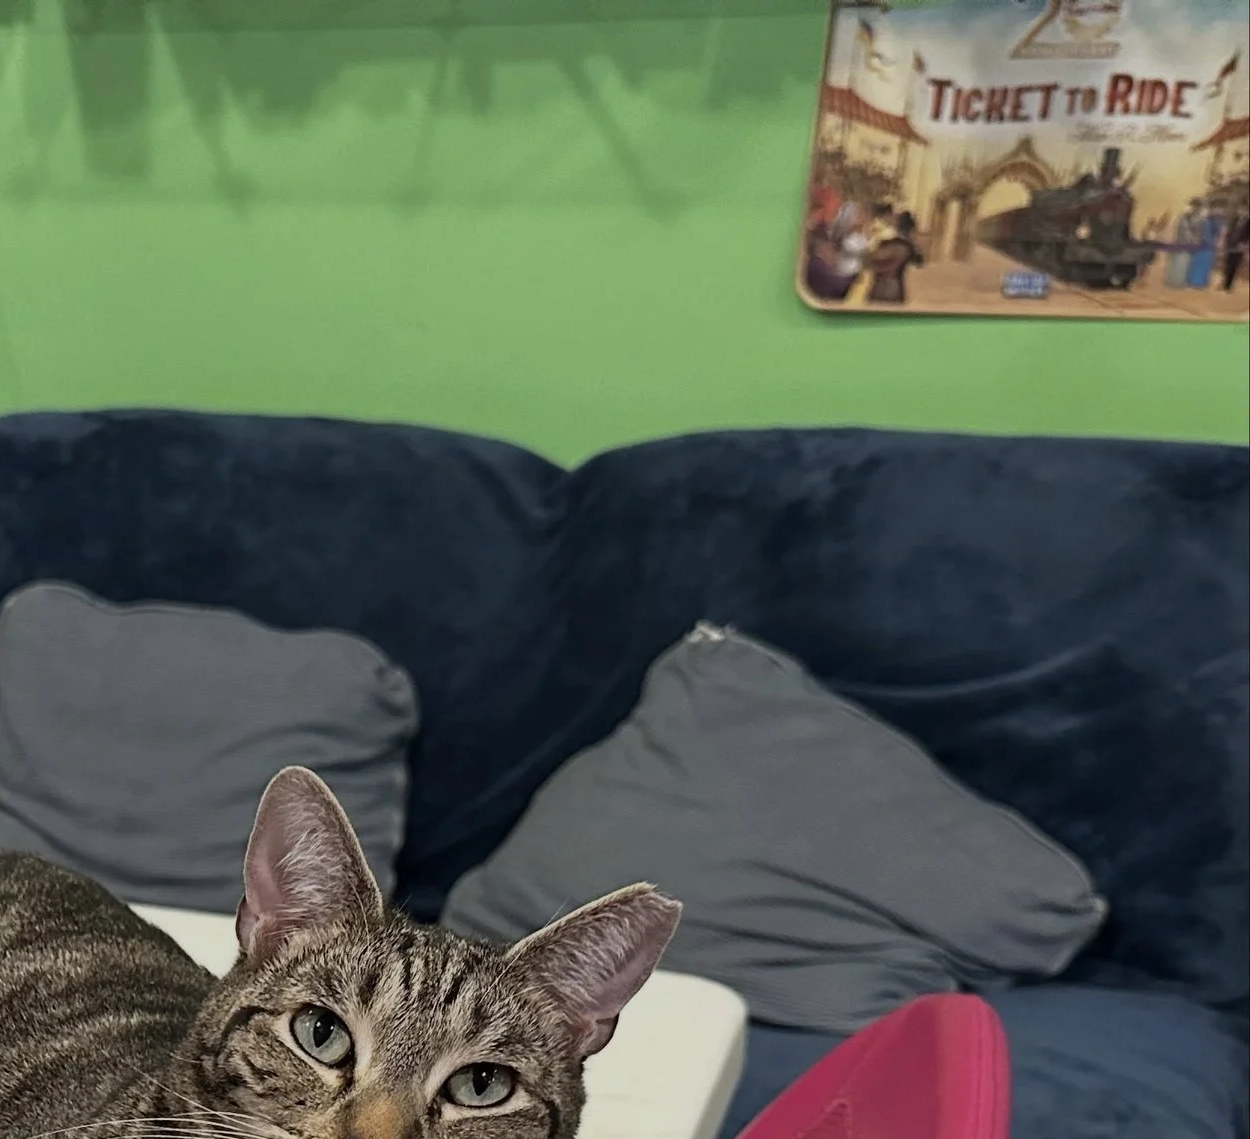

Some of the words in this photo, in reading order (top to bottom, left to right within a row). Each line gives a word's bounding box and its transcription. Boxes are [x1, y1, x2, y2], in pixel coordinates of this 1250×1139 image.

[927, 75, 1059, 124] TICKET
[1066, 88, 1098, 116] TO
[1104, 73, 1197, 119] RIDE
